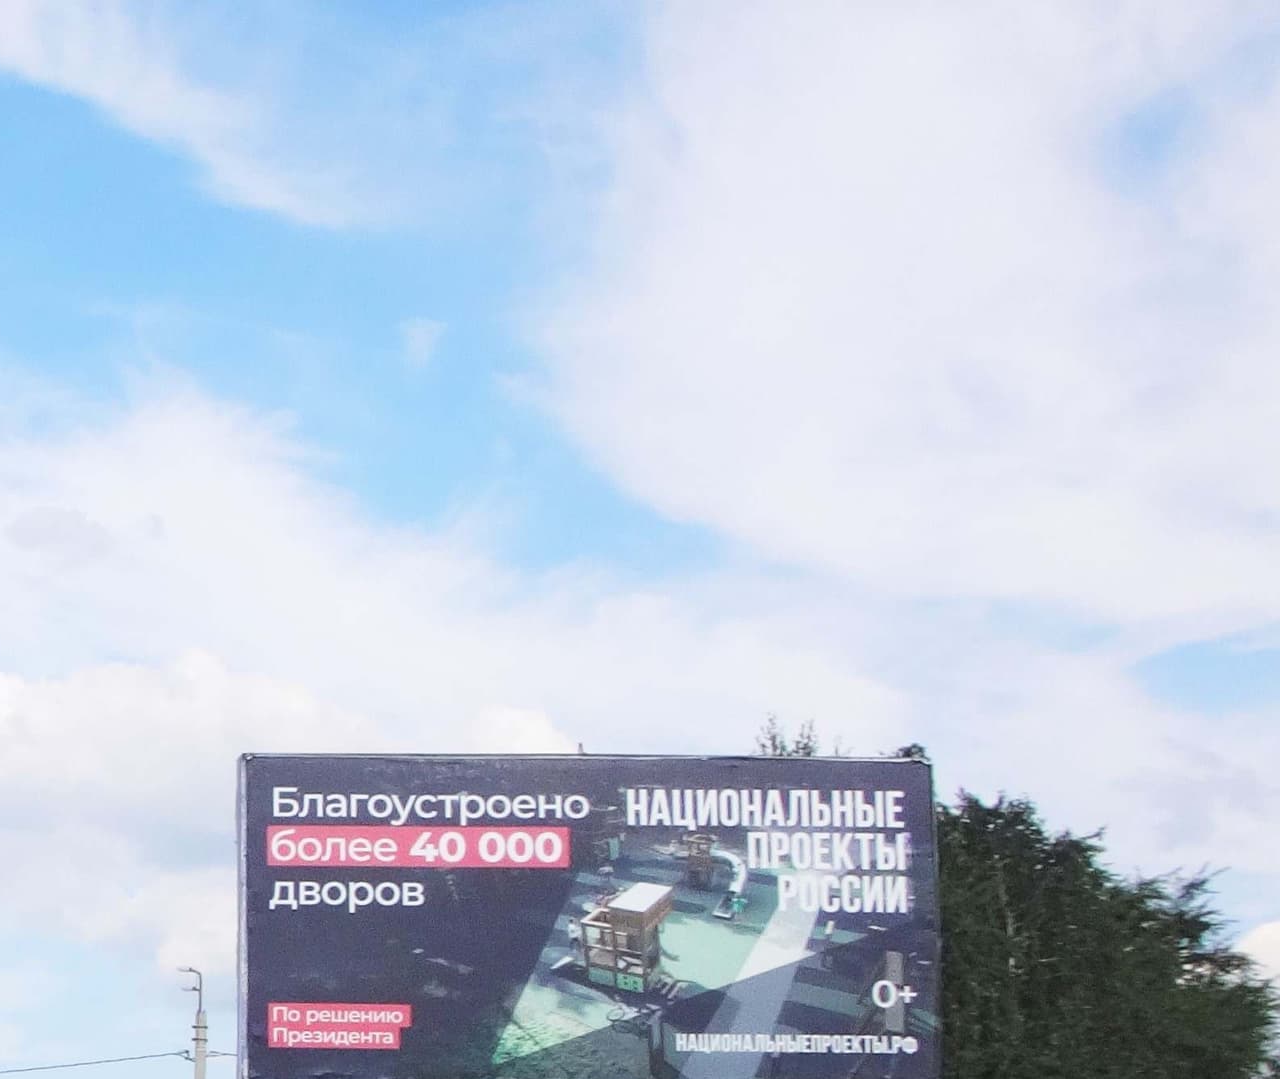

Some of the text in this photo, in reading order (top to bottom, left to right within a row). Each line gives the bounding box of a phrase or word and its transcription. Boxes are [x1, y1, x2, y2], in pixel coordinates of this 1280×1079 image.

[272, 786, 590, 825] Благоустроено
[626, 788, 905, 831] НАЦИОНАЛЬНЫЕ
[271, 829, 563, 863] более 40 000
[747, 832, 910, 871] ПРОЕКТЫ
[269, 880, 425, 913] дворов
[778, 875, 909, 914] РОССИИ
[872, 980, 918, 1008] 0+
[272, 1006, 404, 1025] По решению
[272, 1027, 395, 1047] Президента
[675, 1033, 919, 1054] НАЦИОНАЛЬНЫЕПРОЕКТЫ.РФ
